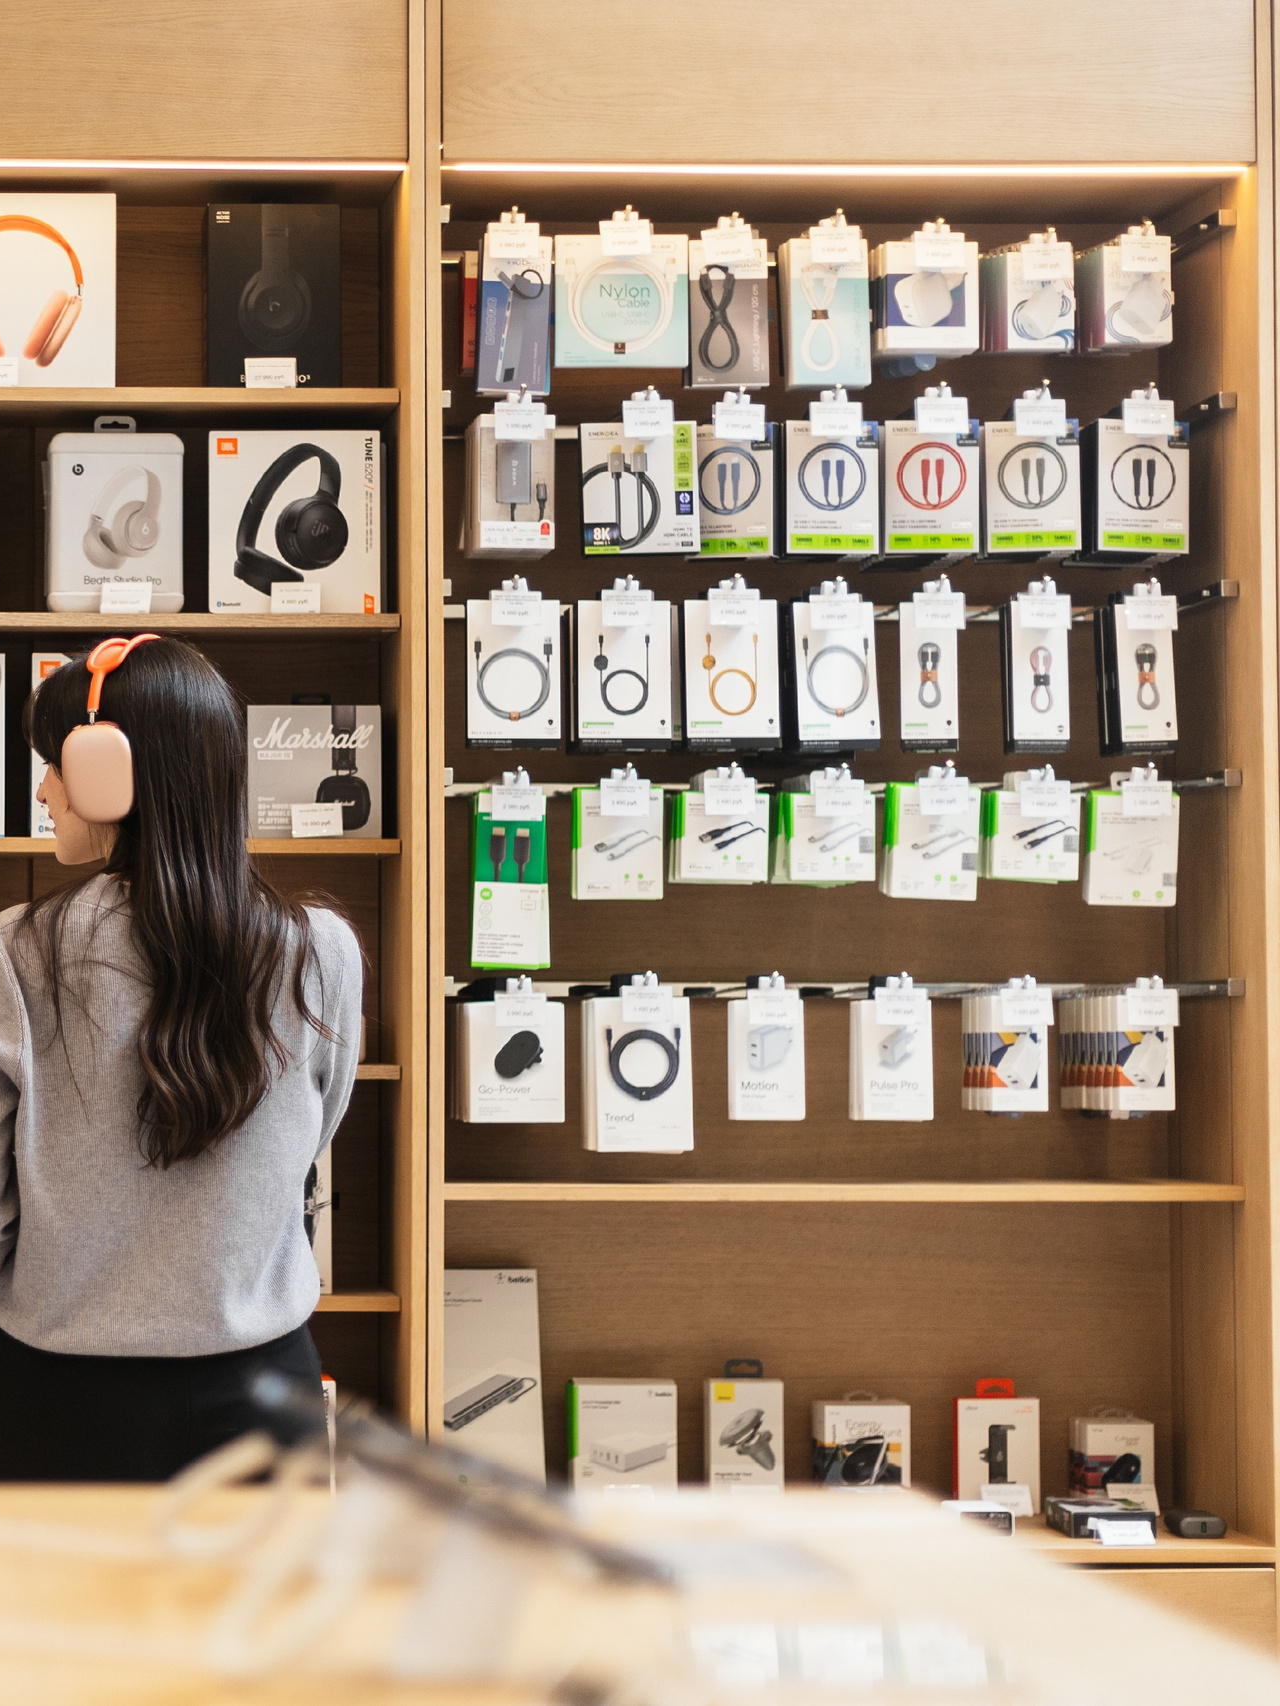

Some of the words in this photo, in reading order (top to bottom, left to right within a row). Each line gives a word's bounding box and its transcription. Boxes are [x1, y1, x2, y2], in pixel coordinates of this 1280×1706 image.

[599, 284, 650, 300] Nylon
[618, 298, 650, 309] Cable
[364, 436, 373, 462] TUNE
[593, 527, 610, 540] 8K
[83, 576, 110, 586] Beats
[146, 576, 162, 586] Pro
[253, 717, 374, 749] Marshall
[478, 1084, 531, 1095] Go-Power
[741, 1080, 779, 1091] Motion
[870, 1080, 897, 1090] Pulse
[900, 1080, 919, 1090] Pro
[604, 1113, 635, 1122] Trend
[844, 1420, 883, 1430] Energy
